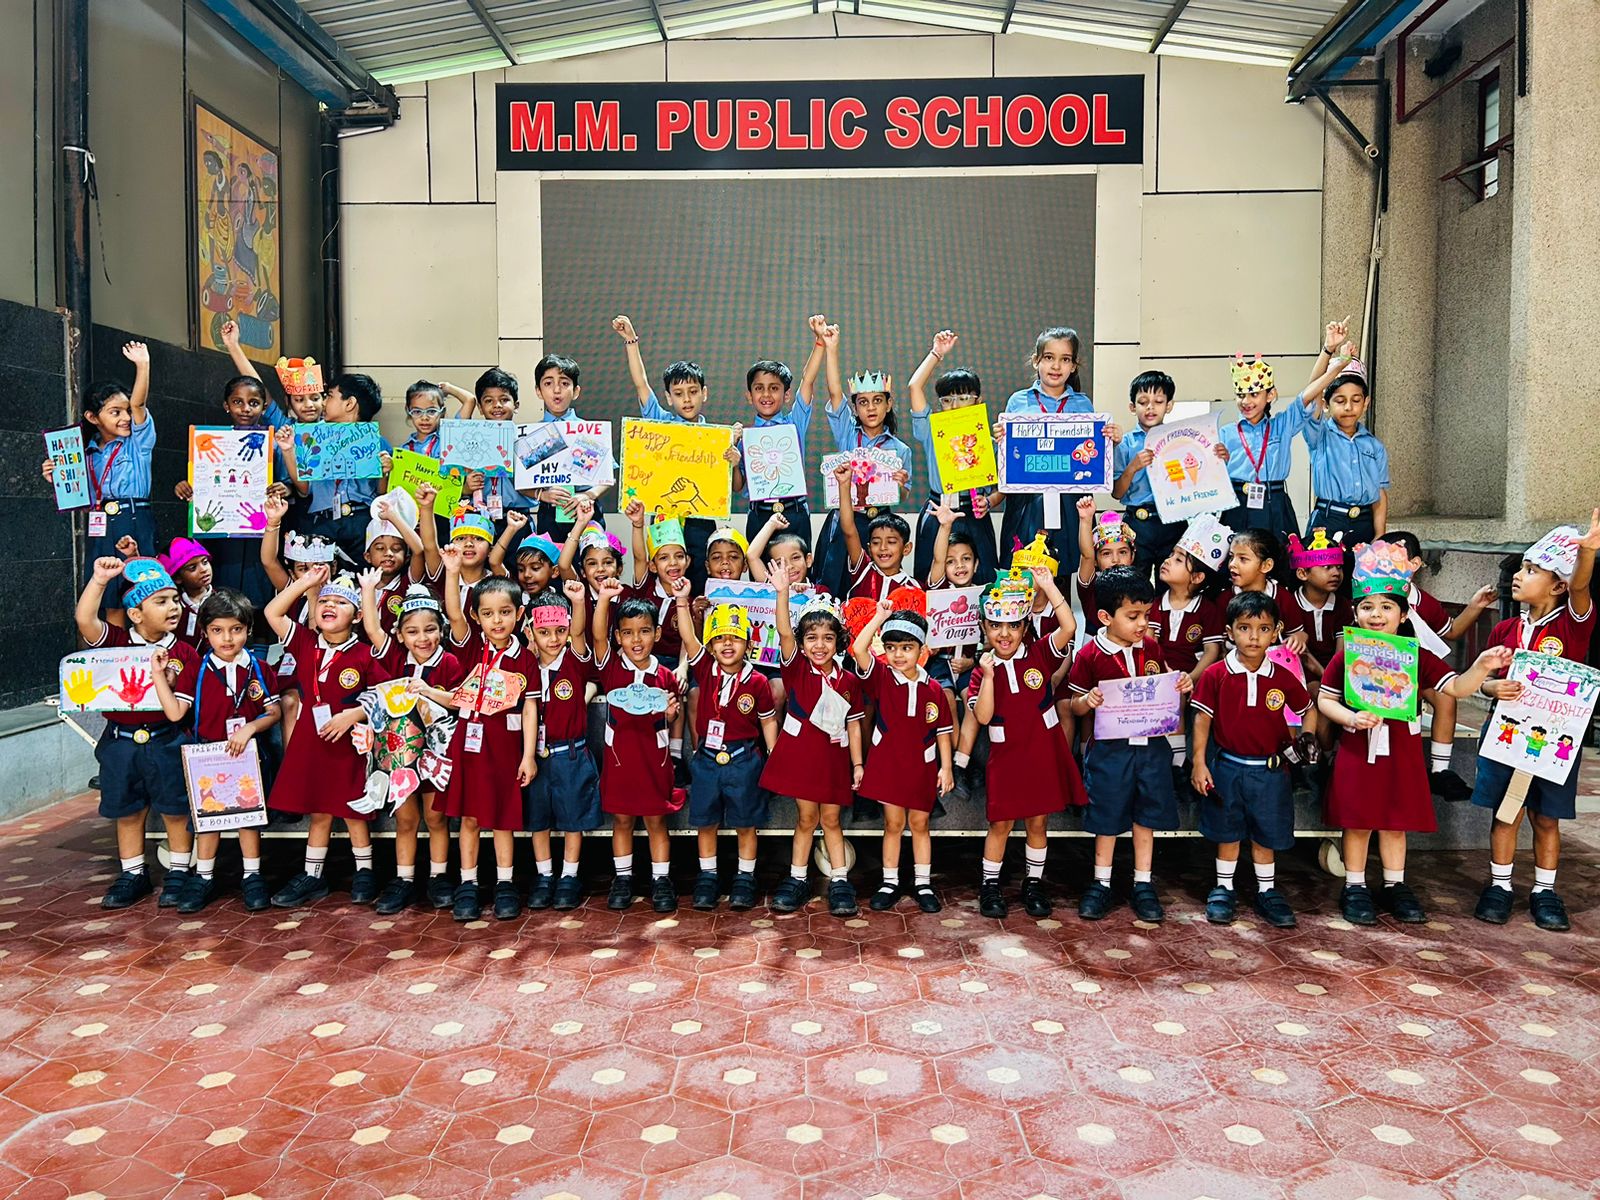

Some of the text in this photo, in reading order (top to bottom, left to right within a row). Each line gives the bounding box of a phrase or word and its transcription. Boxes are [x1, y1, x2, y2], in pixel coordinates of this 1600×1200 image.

[509, 93, 1127, 152] M.M. PUBLIC SCHOOL
[517, 421, 602, 437] I LOVE
[1050, 424, 1093, 436] Friendship
[51, 436, 80, 451] HAPPY
[627, 425, 671, 451] Happy
[52, 451, 82, 466] FRIEND
[350, 442, 376, 460] Day
[541, 462, 559, 474] MY
[822, 448, 902, 472] FRIENDS ARE FLOWERS
[1026, 455, 1069, 471] BESTIE
[60, 469, 80, 481] SHIP
[533, 474, 572, 484] FRIENDS
[628, 464, 653, 486] Day
[65, 481, 80, 494] DAY
[945, 628, 968, 640] Day
[1346, 641, 1415, 665] Friendship
[1519, 689, 1592, 718] RIENDSHIP
